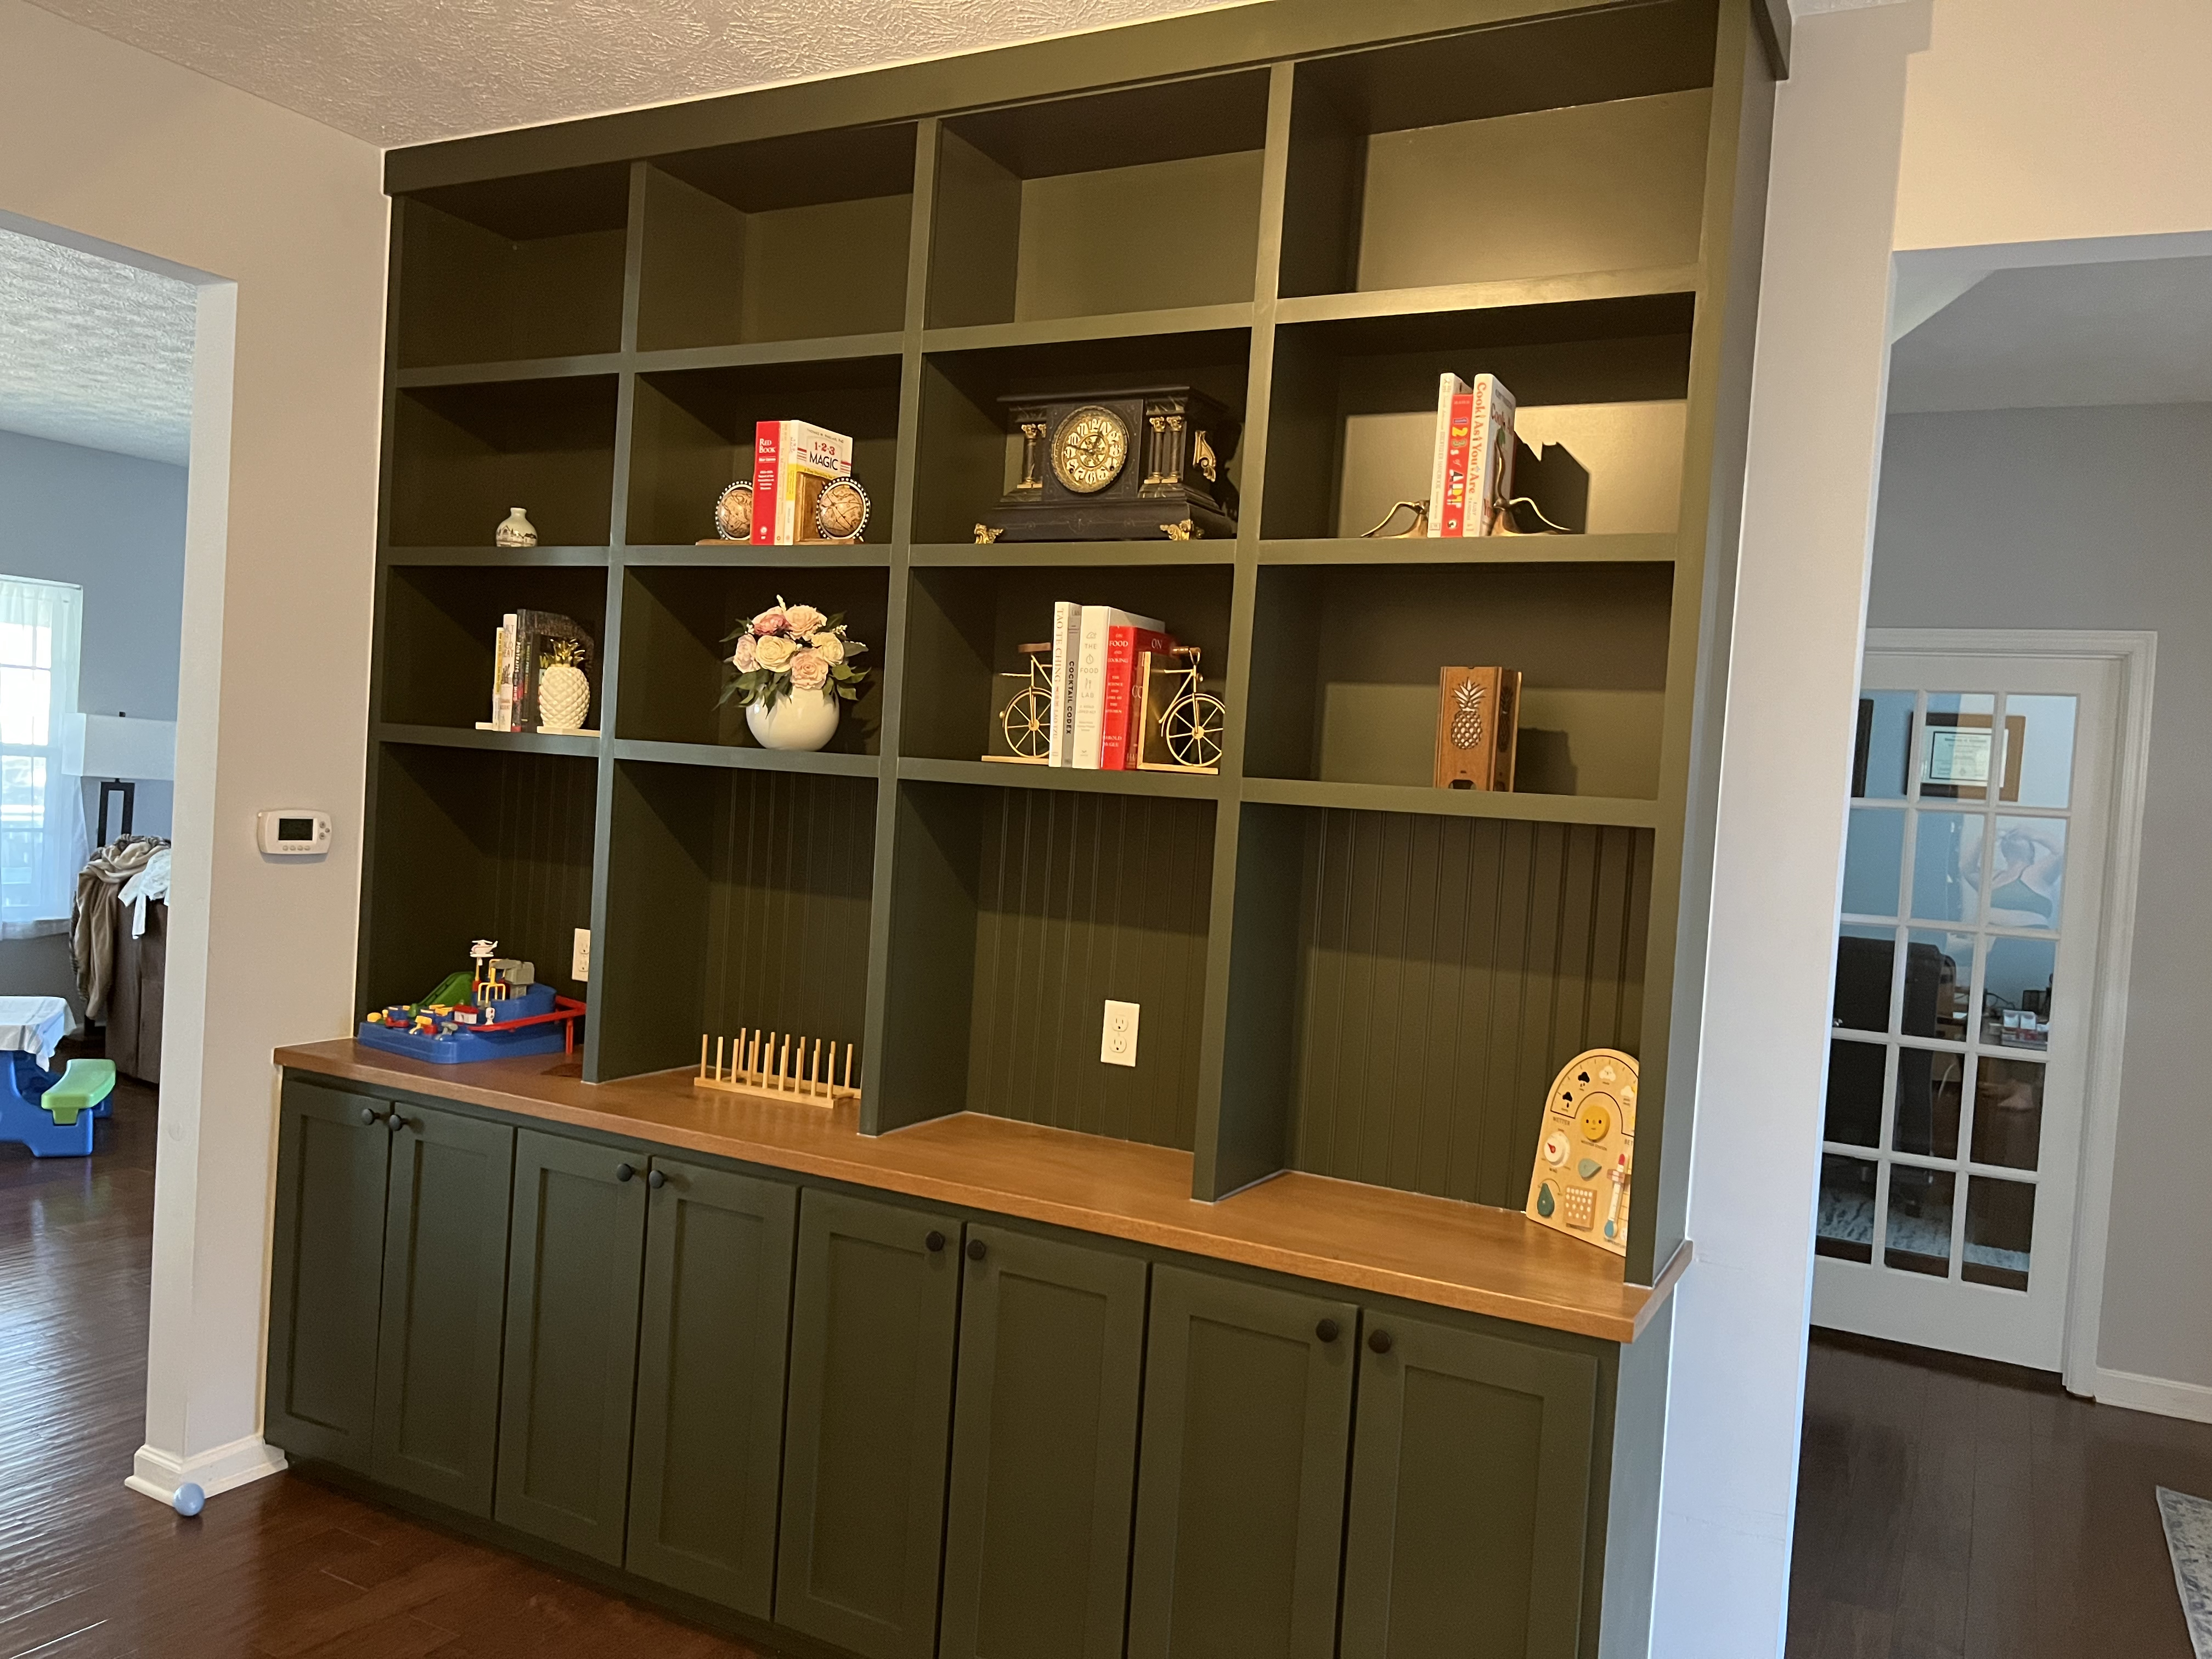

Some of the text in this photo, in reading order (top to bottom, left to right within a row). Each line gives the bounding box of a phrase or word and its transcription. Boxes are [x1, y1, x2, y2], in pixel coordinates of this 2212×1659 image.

[1469, 382, 1487, 494] Cook As You Are
[815, 441, 835, 455] 1-2-3
[1113, 444, 1120, 455] 3
[809, 451, 839, 471] MAGIC
[1446, 469, 1464, 509] ART
[1056, 632, 1063, 646] TE
[1152, 638, 1162, 649] ON
[1054, 648, 1063, 682] CHING
